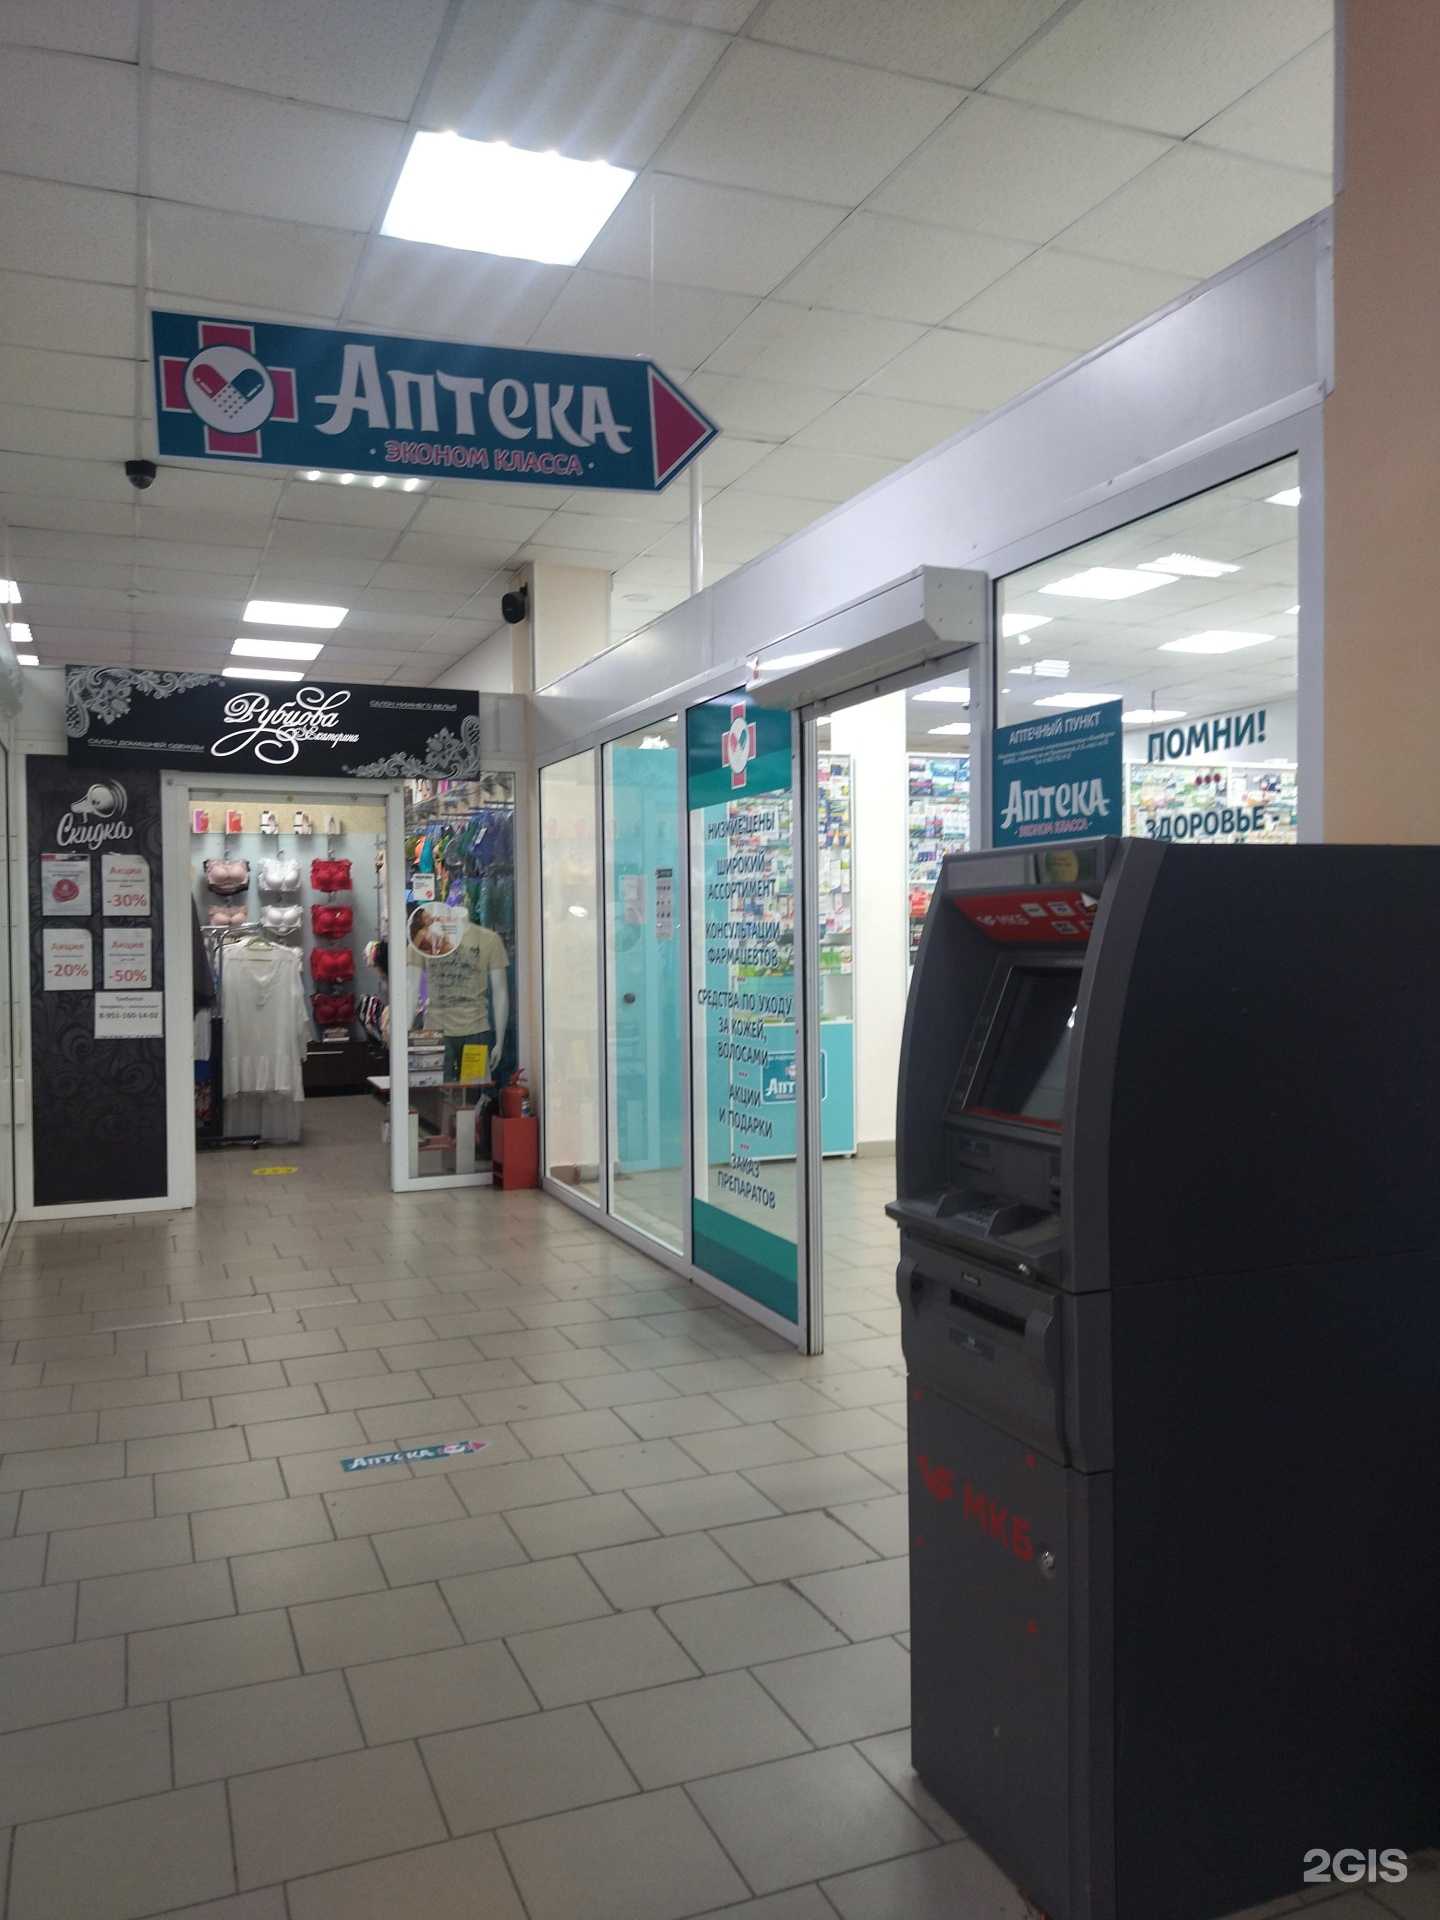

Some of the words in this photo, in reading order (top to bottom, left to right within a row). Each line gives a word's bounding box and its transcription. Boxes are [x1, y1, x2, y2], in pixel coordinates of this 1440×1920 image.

[384, 439, 489, 471] ЭКОНОМ
[493, 448, 584, 476] КЛАССА
[1008, 718, 1063, 745] АПТЕЧНЫЙ
[1064, 711, 1101, 732] ПУНКТ
[1147, 709, 1266, 765] ПОМНИ!
[56, 812, 134, 850] Скидка
[708, 814, 744, 840] НИЗКИЕ
[745, 812, 776, 837] ЦЕНЫ
[1146, 805, 1265, 841] ЗДОРОВЬЕ
[716, 849, 766, 876] ШИРОКИЙ
[106, 894, 148, 908] -30%
[708, 878, 777, 900] АССОРТИМЕНТ
[705, 921, 781, 941] КОНСУЛЬТАЦИИ
[47, 963, 89, 977] -20%
[707, 947, 778, 967] ФАРМАЦЕВТОВ
[108, 969, 148, 983] -50%
[697, 989, 739, 1008] СРЕДСТВА
[742, 993, 756, 1011] ПО
[758, 993, 793, 1017] УХОДУ
[718, 1016, 729, 1034] ЗА
[730, 1019, 767, 1041] КОЖЕЙ,
[717, 1041, 769, 1067] ВОЛОСАМИ
[728, 1084, 761, 1107] АКЦИИ
[718, 1107, 727, 1123] И
[728, 1110, 773, 1139] ПОДАРКИ
[731, 1152, 761, 1179] ЗАКАЗ
[717, 1170, 776, 1210] ПРЕПАРАТОВ
